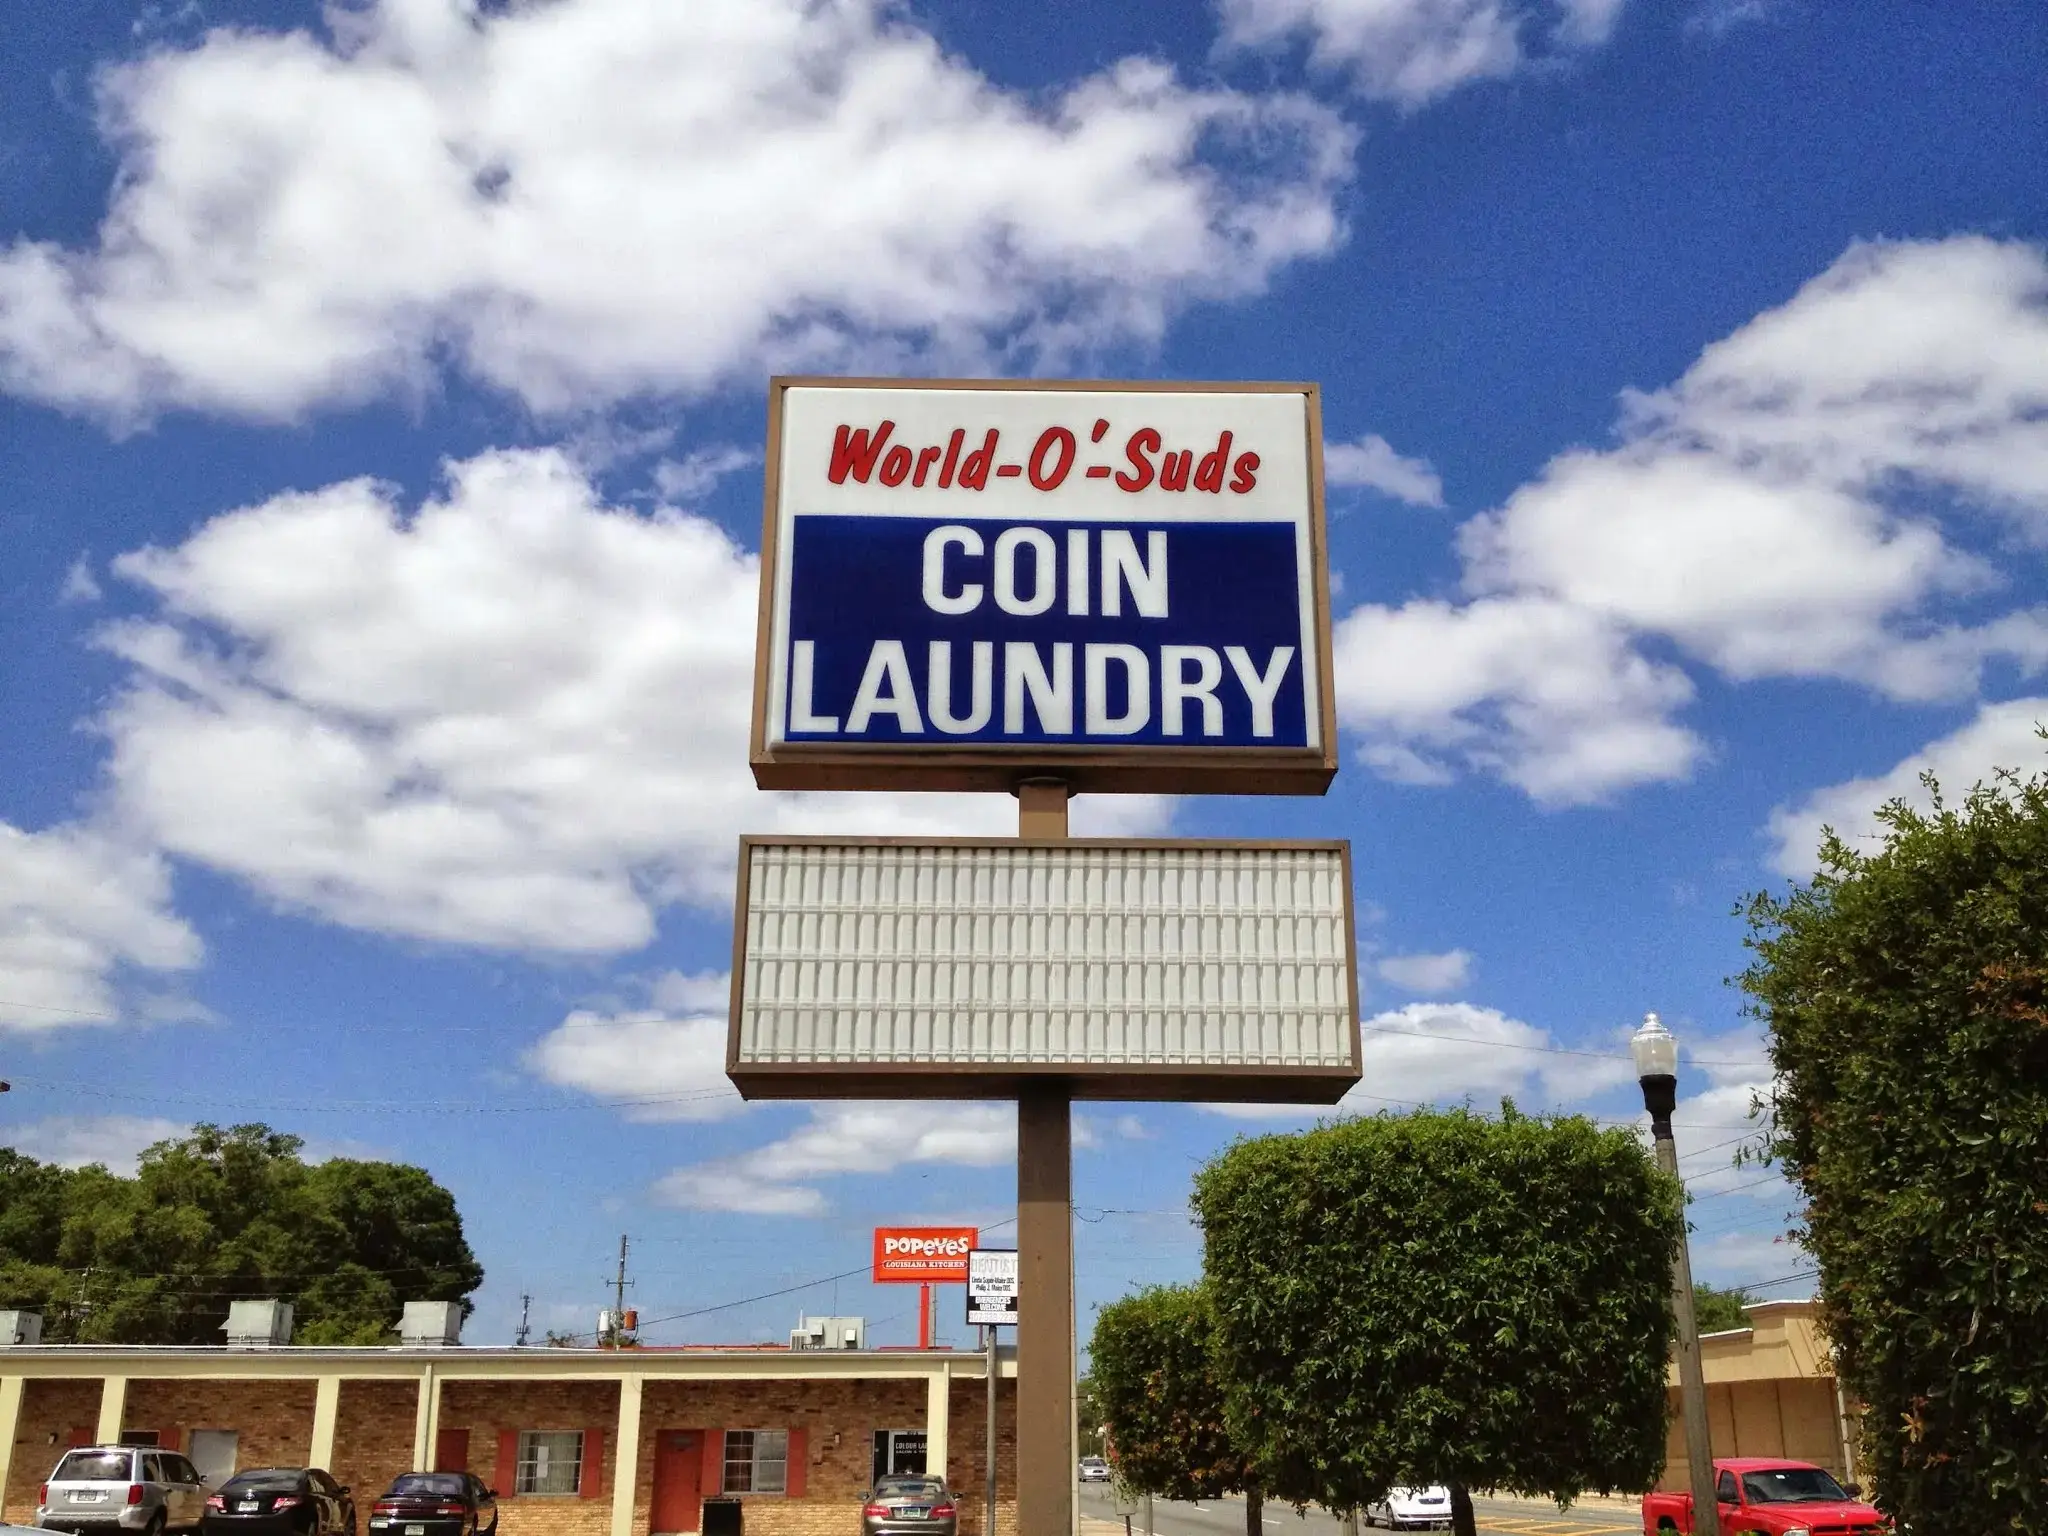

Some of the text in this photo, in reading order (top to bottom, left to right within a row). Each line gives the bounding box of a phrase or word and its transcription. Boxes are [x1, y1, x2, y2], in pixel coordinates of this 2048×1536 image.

[828, 419, 1261, 494] World-O'-Suds
[922, 525, 1169, 618] COIN
[789, 640, 1295, 737] LAUNDRY
[979, 1303, 1007, 1311] WELCOME
